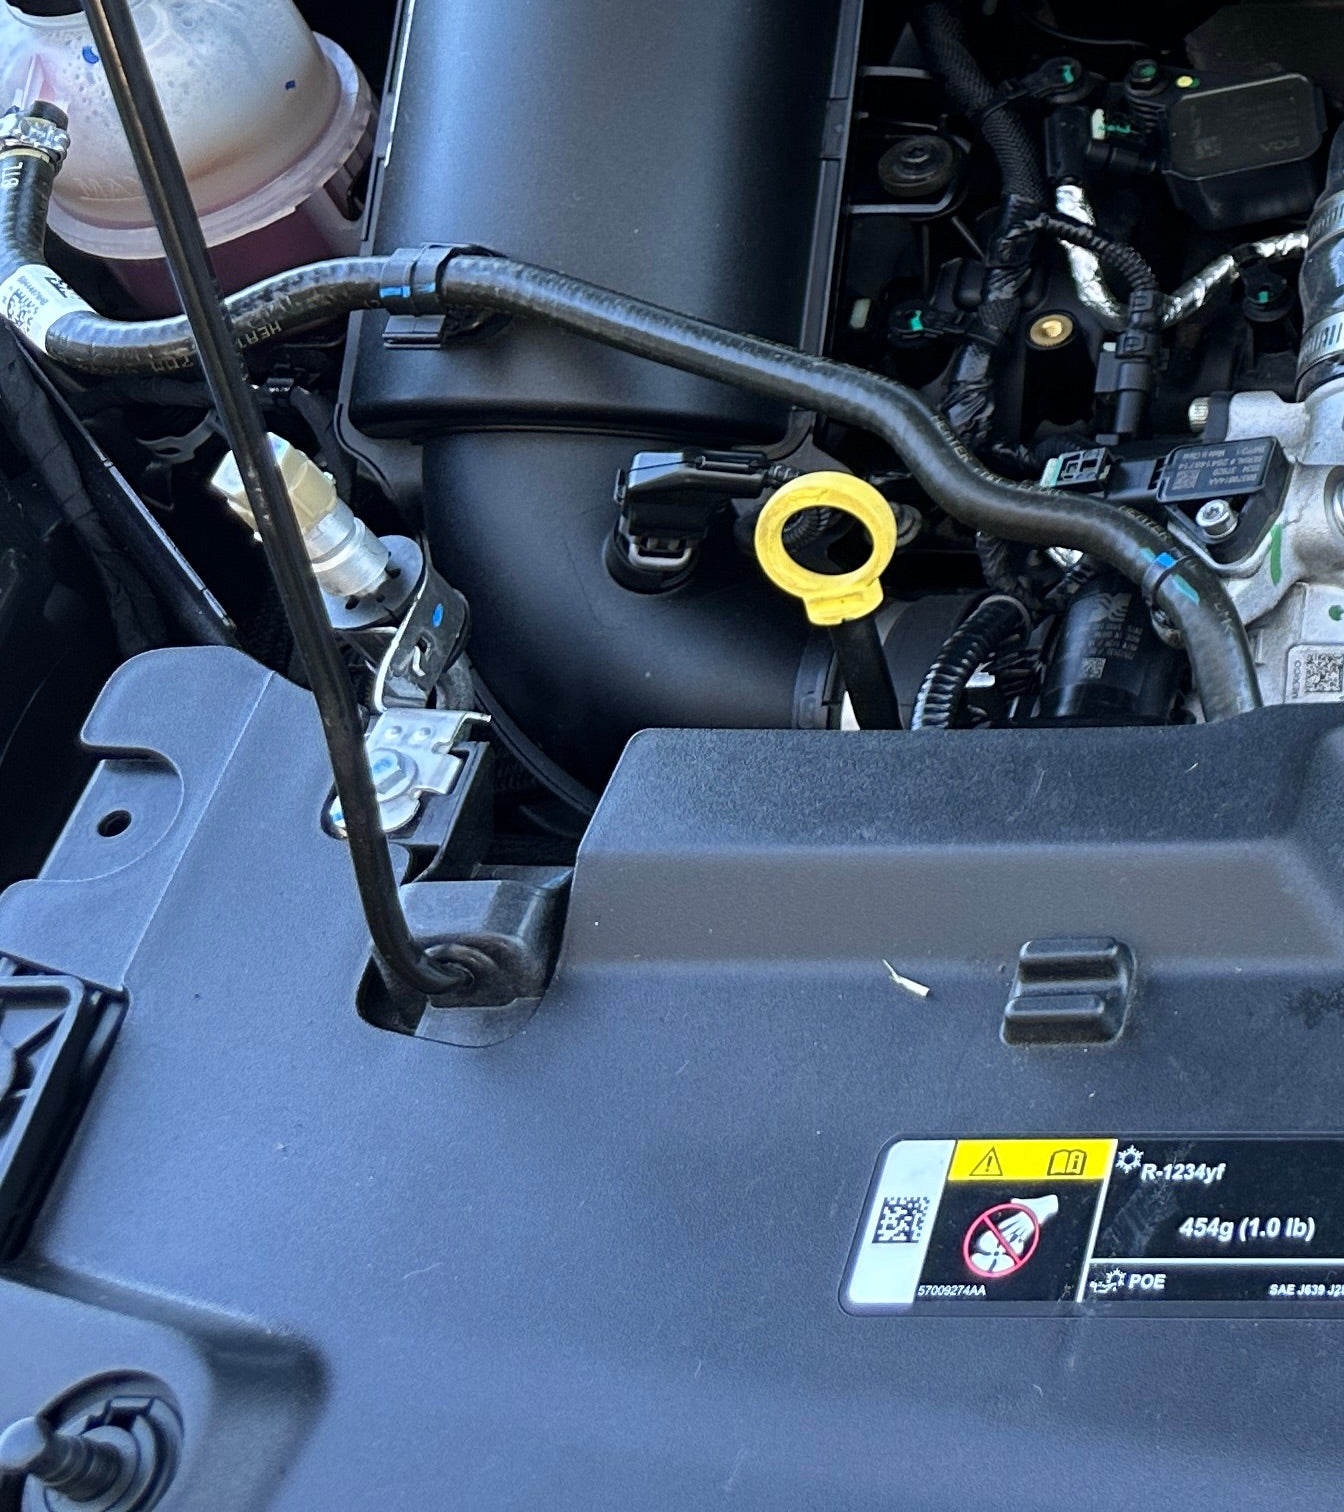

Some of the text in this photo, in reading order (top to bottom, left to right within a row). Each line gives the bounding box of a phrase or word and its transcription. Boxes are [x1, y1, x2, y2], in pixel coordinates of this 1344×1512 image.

[1140, 1161, 1226, 1184] R-1234yf
[1178, 1217, 1316, 1242] 454g (1.0 lb)
[917, 1284, 987, 1297] 57009274AA
[1129, 1273, 1166, 1291] POE
[1269, 1283, 1295, 1296] SAE
[1297, 1283, 1325, 1296] J639
